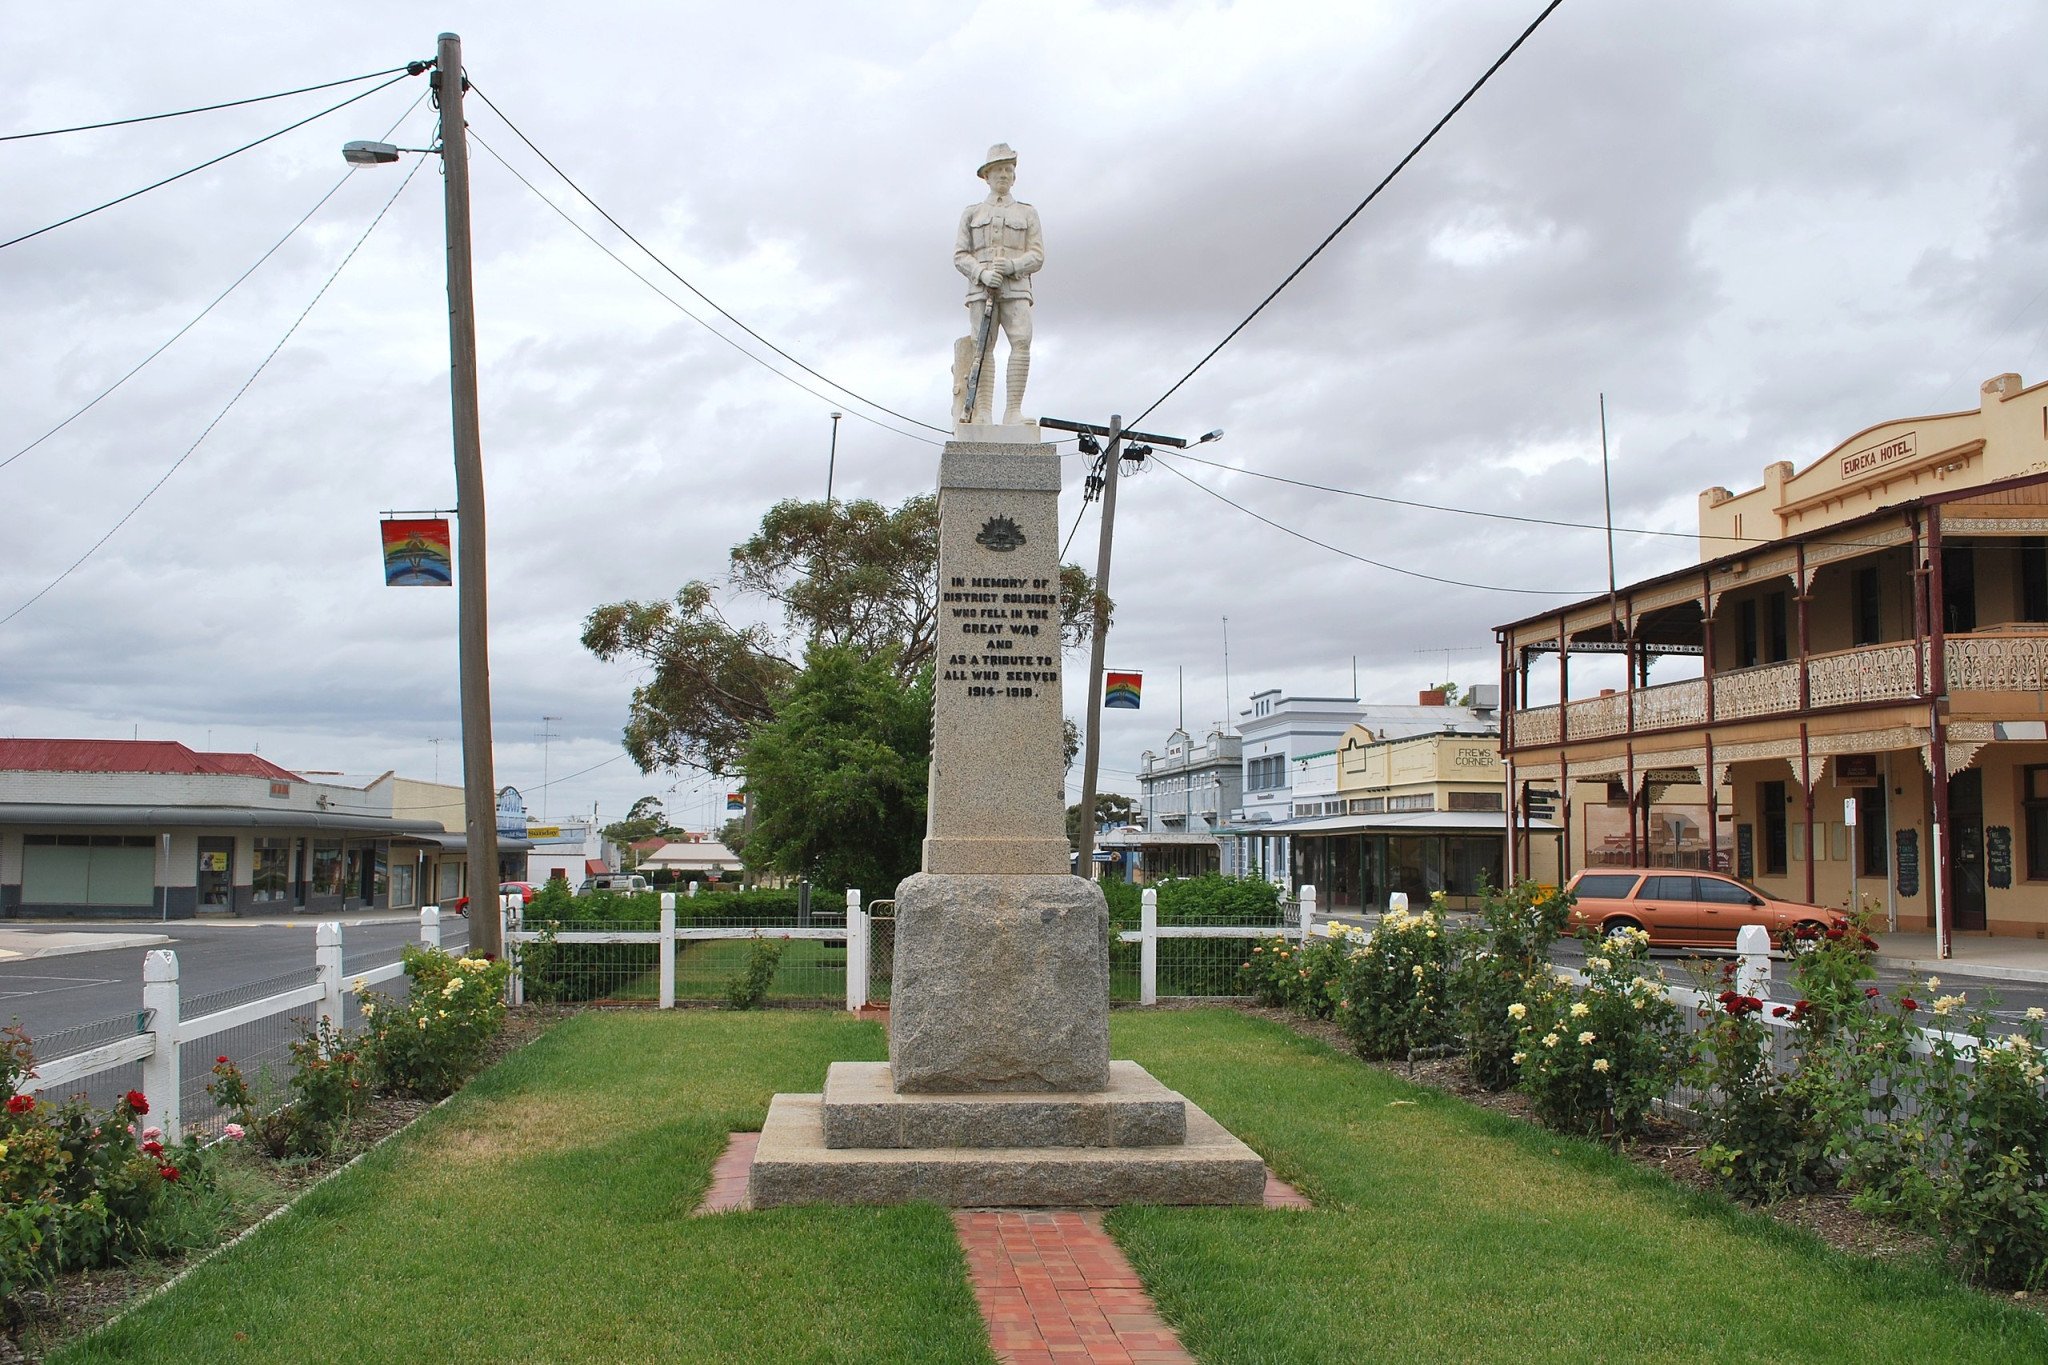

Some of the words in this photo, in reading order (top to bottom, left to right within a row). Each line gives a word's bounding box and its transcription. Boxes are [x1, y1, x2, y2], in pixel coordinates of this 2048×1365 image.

[1844, 452, 1877, 475] EUREKA
[952, 577, 965, 587] IN
[971, 577, 1028, 588] MEMORY
[1033, 579, 1050, 589] OF
[943, 592, 998, 603] DISTRICT
[1003, 593, 1057, 604] SOLDIERS
[952, 608, 977, 618] WHO
[980, 609, 1008, 619] FELL
[1010, 609, 1023, 619] IN
[1026, 609, 1049, 619] THE
[962, 623, 1003, 634] GREAT
[1009, 624, 1039, 636] WAR
[986, 639, 1013, 649] AND
[949, 654, 967, 665] AS
[970, 655, 979, 665] A
[982, 655, 1034, 666] TRIBUTE
[1036, 656, 1052, 666] TO
[943, 670, 968, 681] ALL
[971, 671, 999, 681] WHO
[1006, 671, 1057, 682] SERVED
[1458, 748, 1491, 757] FREWS
[1455, 757, 1494, 766] CORNER
[527, 828, 558, 837] Sunday
